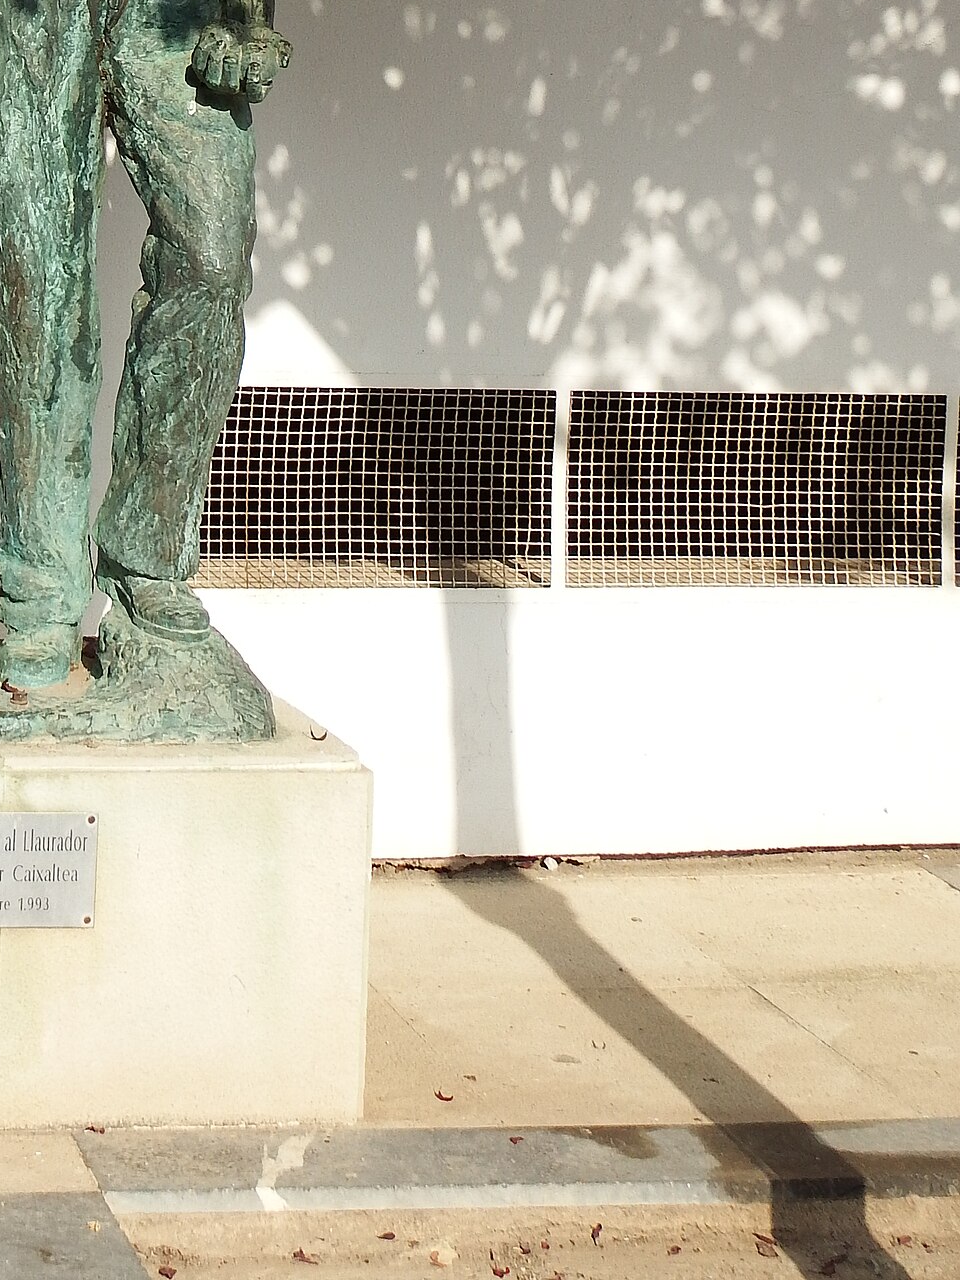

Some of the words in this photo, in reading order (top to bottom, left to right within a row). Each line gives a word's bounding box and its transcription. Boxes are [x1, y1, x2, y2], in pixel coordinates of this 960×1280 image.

[4, 828, 16, 852] al
[23, 828, 88, 852] Llaurador
[13, 863, 78, 882] Caixaltea
[18, 897, 50, 911] 1.993
